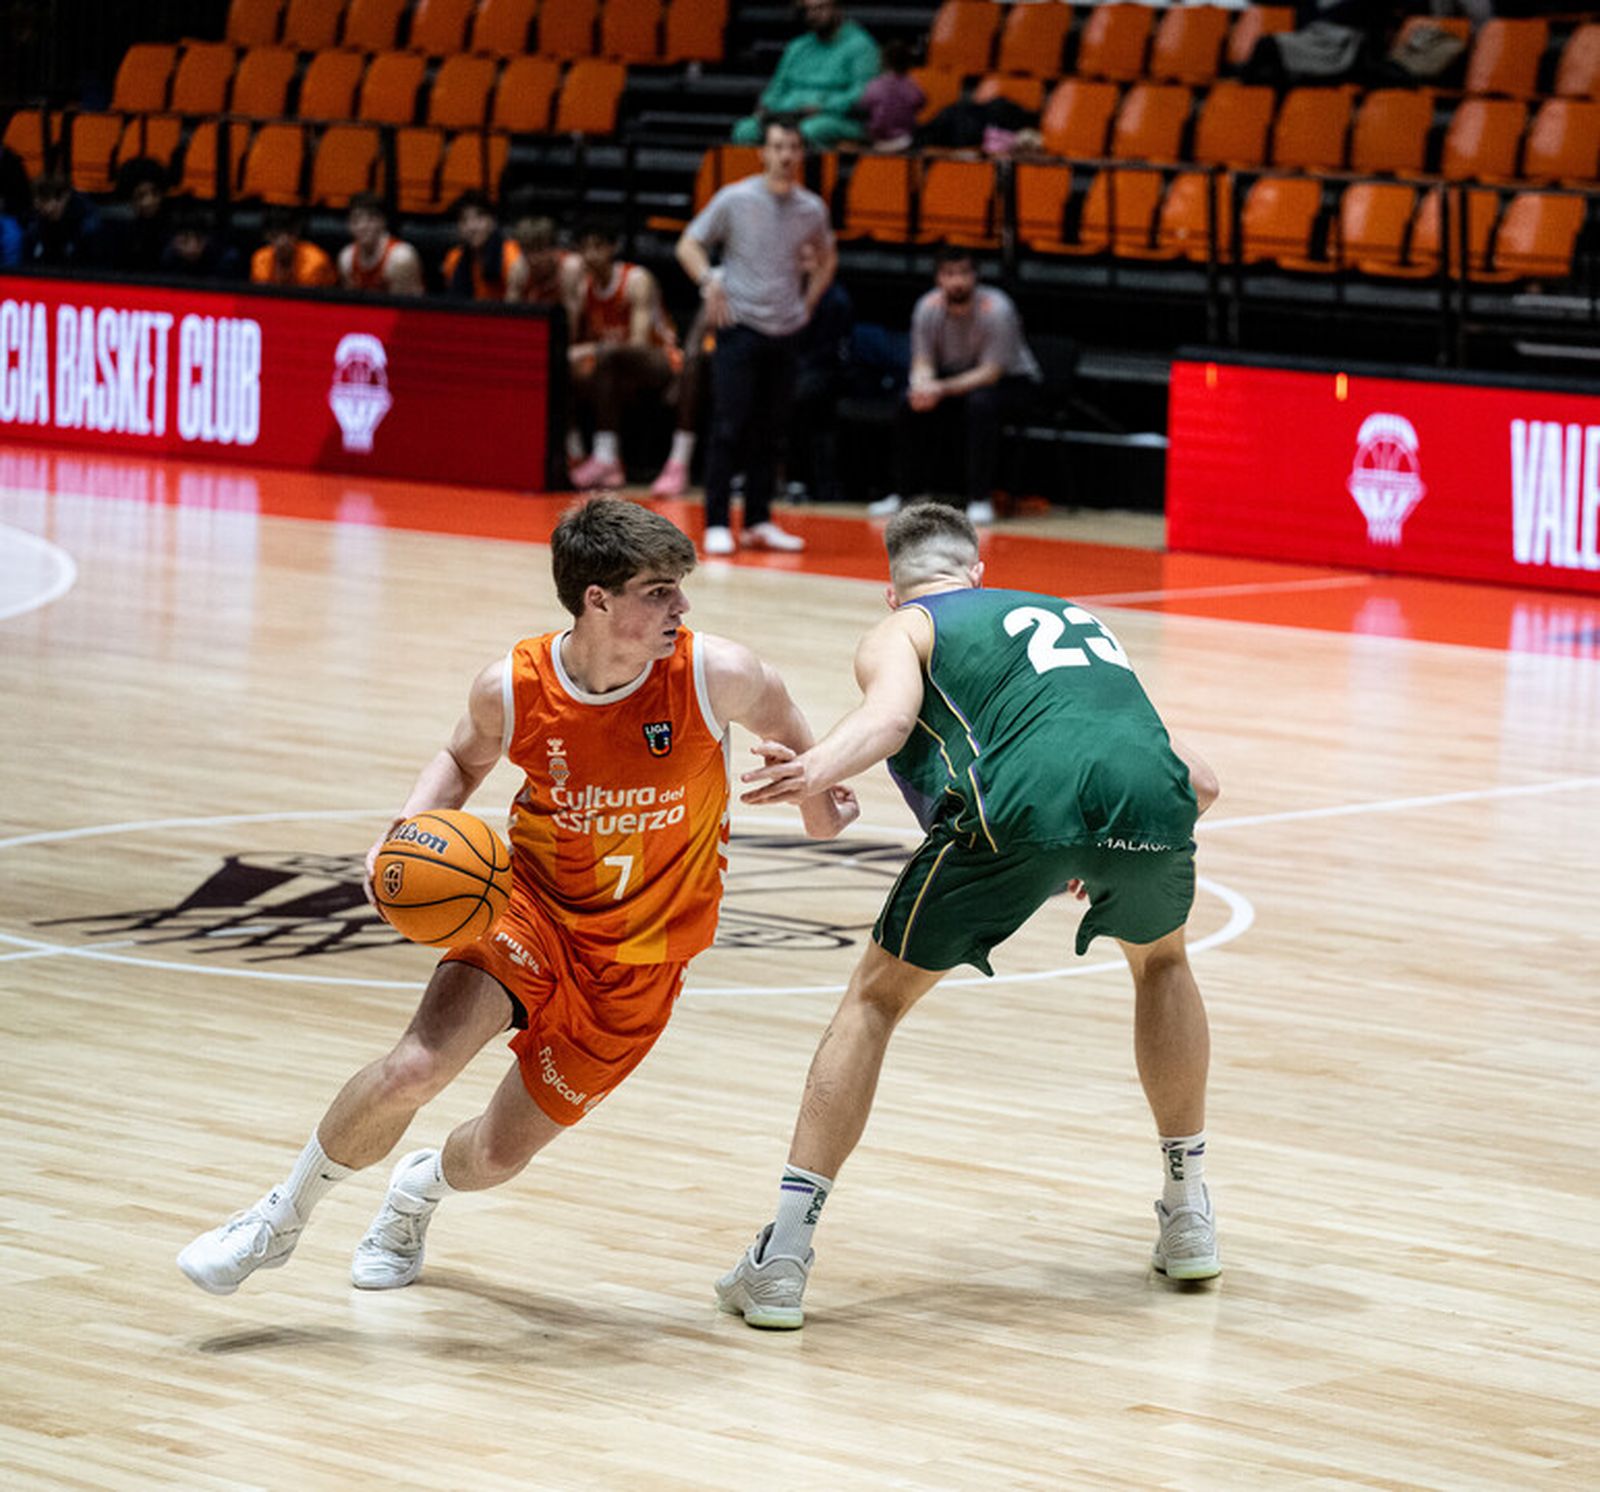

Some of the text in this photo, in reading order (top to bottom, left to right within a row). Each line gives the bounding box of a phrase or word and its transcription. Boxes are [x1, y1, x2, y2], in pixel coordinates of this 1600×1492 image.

[0, 299, 262, 445] CIA BASKET CLUB
[1003, 606, 1133, 675] 23
[644, 723, 671, 735] LIGA
[550, 784, 686, 811] Cultura del
[603, 855, 634, 900] 7
[539, 1046, 588, 1106] Frigicoll
